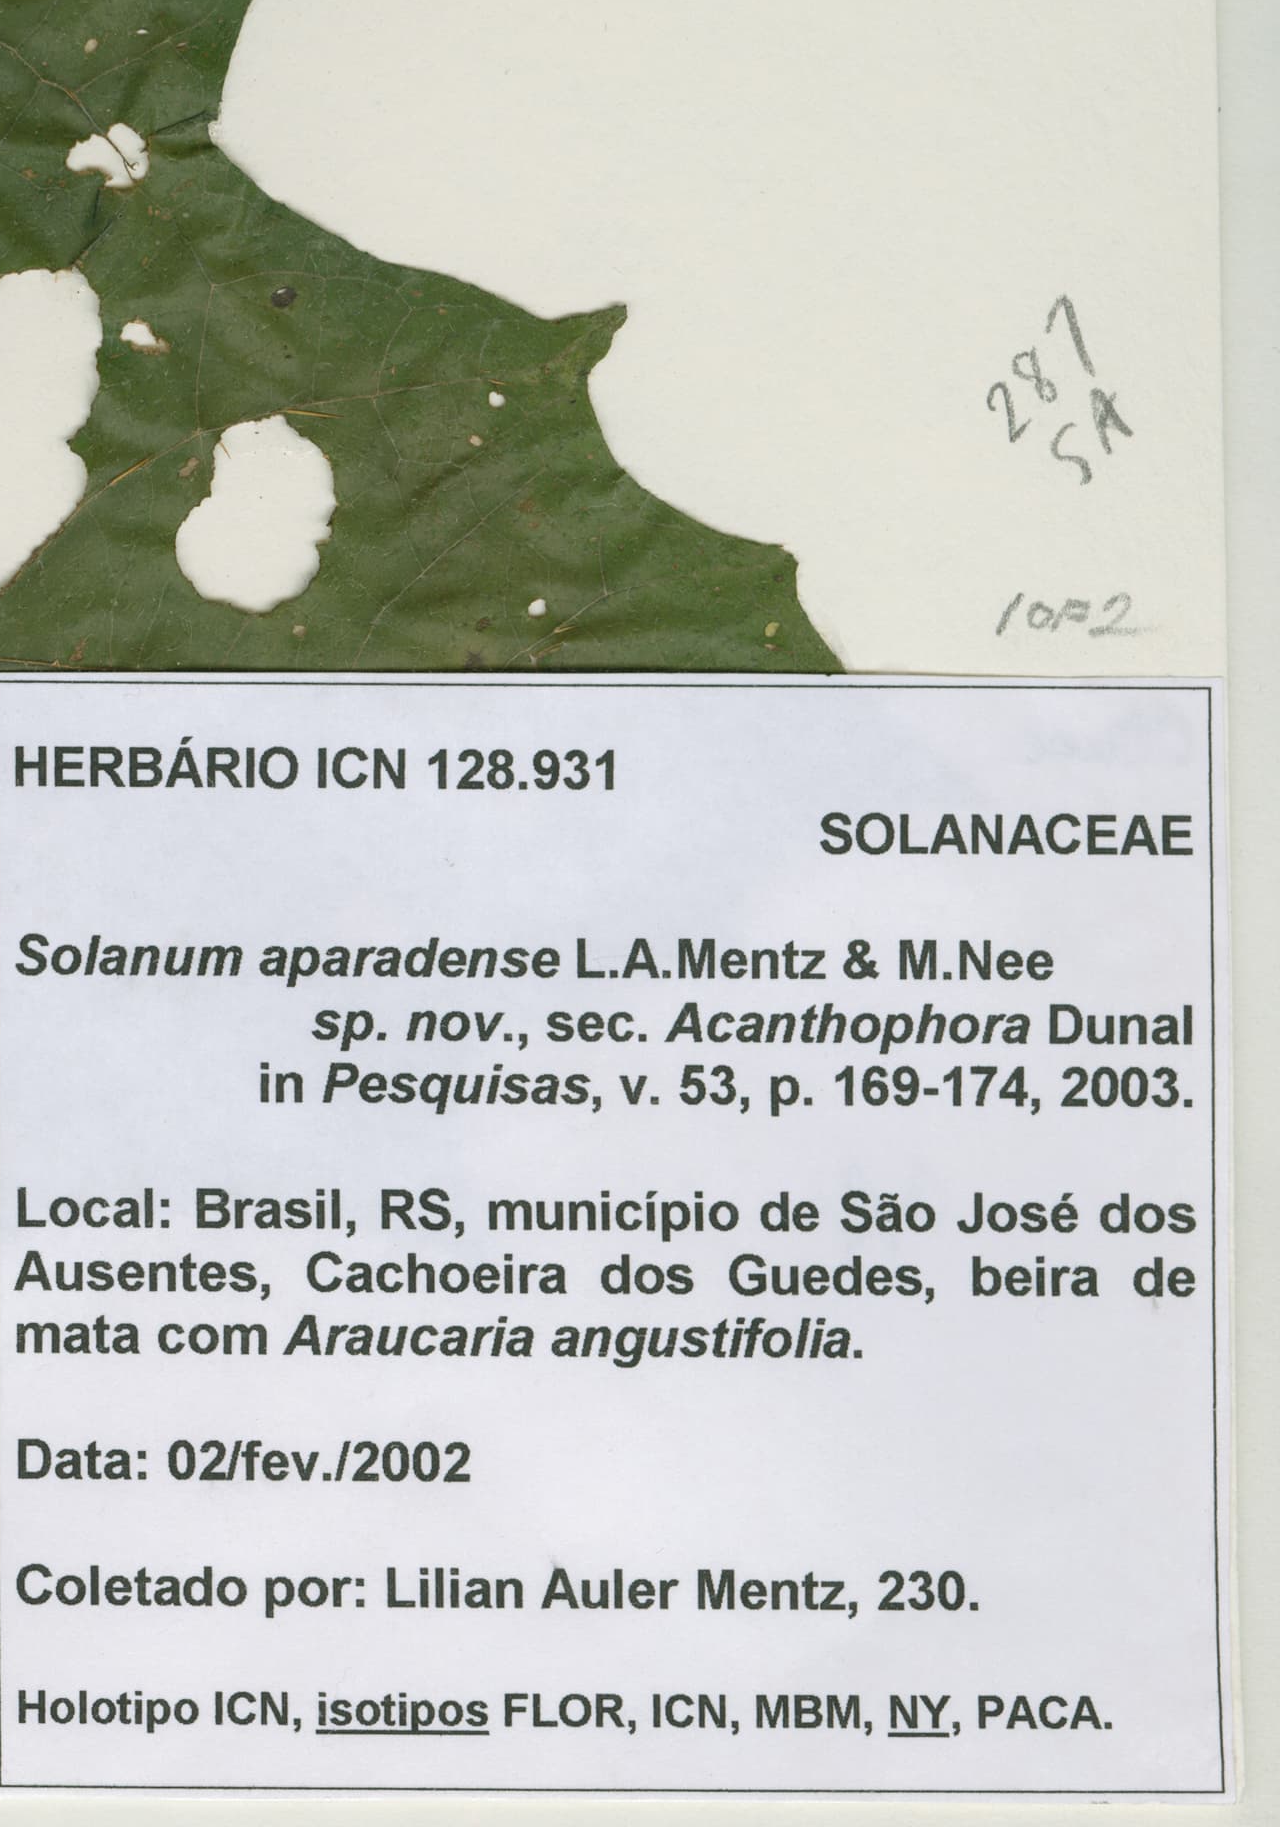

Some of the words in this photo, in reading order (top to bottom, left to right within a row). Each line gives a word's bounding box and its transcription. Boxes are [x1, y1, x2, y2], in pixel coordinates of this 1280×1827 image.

[16, 737, 300, 791] HERBÁRIO
[318, 747, 407, 790] ICN
[429, 749, 615, 792] 128.931
[821, 813, 1194, 857] SOLANACEAE
[16, 934, 244, 978] Solanum
[260, 938, 561, 989] aparadense
[577, 939, 827, 981] L.A.Mentz
[844, 940, 880, 981] &
[900, 940, 1055, 982] M.Nee
[312, 1010, 388, 1055] sp.
[407, 1011, 529, 1054] nov.,
[548, 1012, 648, 1044] sec.
[666, 1003, 1032, 1055] Acanthophora
[1050, 1004, 1194, 1046] Dunal
[261, 1063, 305, 1104] in
[323, 1063, 603, 1116] Pesquisas,
[620, 1076, 660, 1106] v.
[680, 1065, 751, 1115] 53,
[771, 1075, 814, 1118] p.
[836, 1066, 1042, 1117] 169-174,
[1062, 1067, 1194, 1109] 2003.
[18, 1187, 171, 1230] Local:
[197, 1188, 357, 1239] Brasil,
[382, 1188, 466, 1240] RS,
[489, 1191, 740, 1243] município
[761, 1192, 821, 1233] de
[841, 1191, 937, 1235] São
[958, 1193, 1080, 1235] José
[1100, 1194, 1198, 1235] dos
[15, 1251, 271, 1302] Ausentes,
[307, 1251, 568, 1295] Cachoeira
[601, 1254, 695, 1296] dos
[729, 1254, 936, 1303] Guedes,
[973, 1256, 1100, 1298] beira
[1134, 1257, 1197, 1299] de
[17, 1316, 141, 1355] mata
[158, 1324, 268, 1356] com
[284, 1315, 535, 1358] Araucaria
[552, 1318, 864, 1370] angustifolia.
[18, 1439, 148, 1481] Data:
[168, 1440, 472, 1484] 02/fev./2002
[17, 1564, 249, 1608] Coletado
[266, 1577, 366, 1620] por:
[387, 1568, 524, 1610] Lilian
[542, 1568, 680, 1611] Auler
[698, 1570, 859, 1620] Mentz,
[878, 1571, 980, 1612] 230.
[19, 1690, 200, 1735] Holotipo
[215, 1692, 302, 1734] ICN,
[316, 1692, 491, 1737] isotipos
[505, 1694, 637, 1736] FLOR,
[653, 1694, 740, 1736] ICN,
[756, 1695, 874, 1737] MBM,
[888, 1695, 962, 1739] NY,
[978, 1696, 1114, 1731] PACA.
